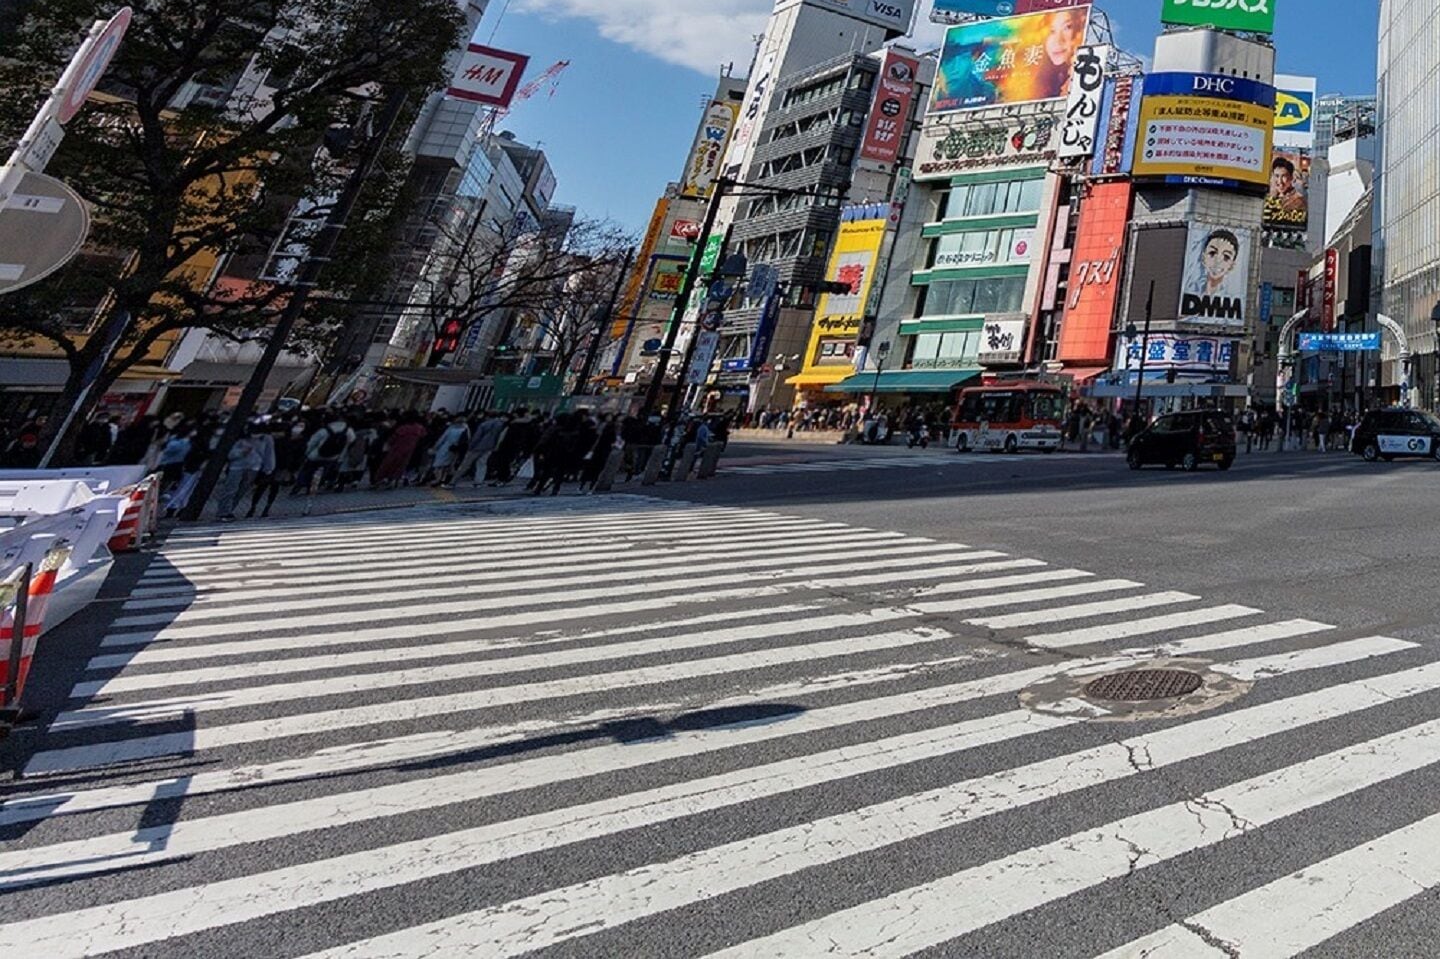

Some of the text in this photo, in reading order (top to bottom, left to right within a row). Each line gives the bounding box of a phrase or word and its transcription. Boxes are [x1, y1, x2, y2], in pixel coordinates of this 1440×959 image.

[872, 0, 902, 18] VISA
[973, 45, 1044, 74] 金魚妻
[1061, 45, 1102, 151] もんじゃ
[1192, 76, 1235, 93] DHC
[1181, 293, 1242, 320] DMM
